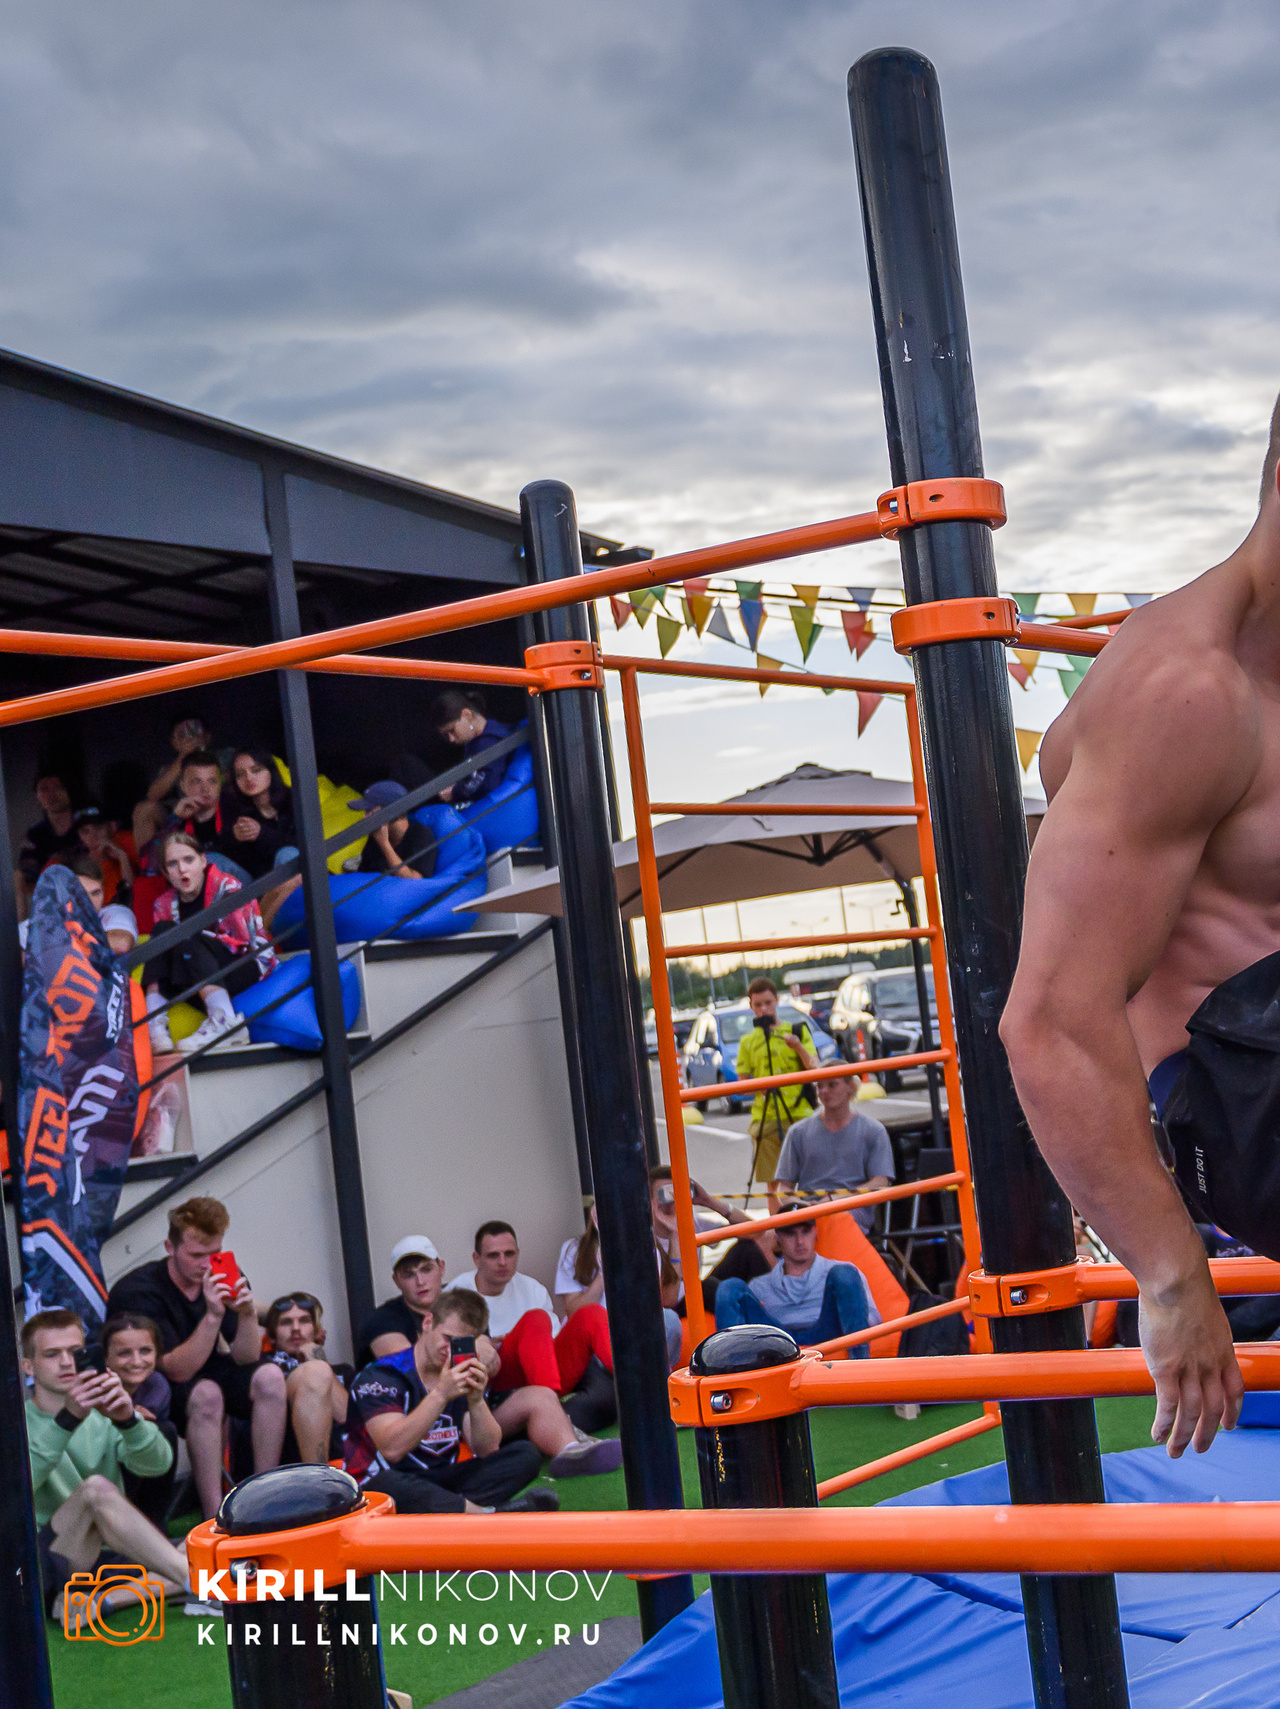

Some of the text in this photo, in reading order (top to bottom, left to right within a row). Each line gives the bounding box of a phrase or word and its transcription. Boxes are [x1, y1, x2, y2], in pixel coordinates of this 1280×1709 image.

[1195, 1145, 1207, 1193] JUST DO IT
